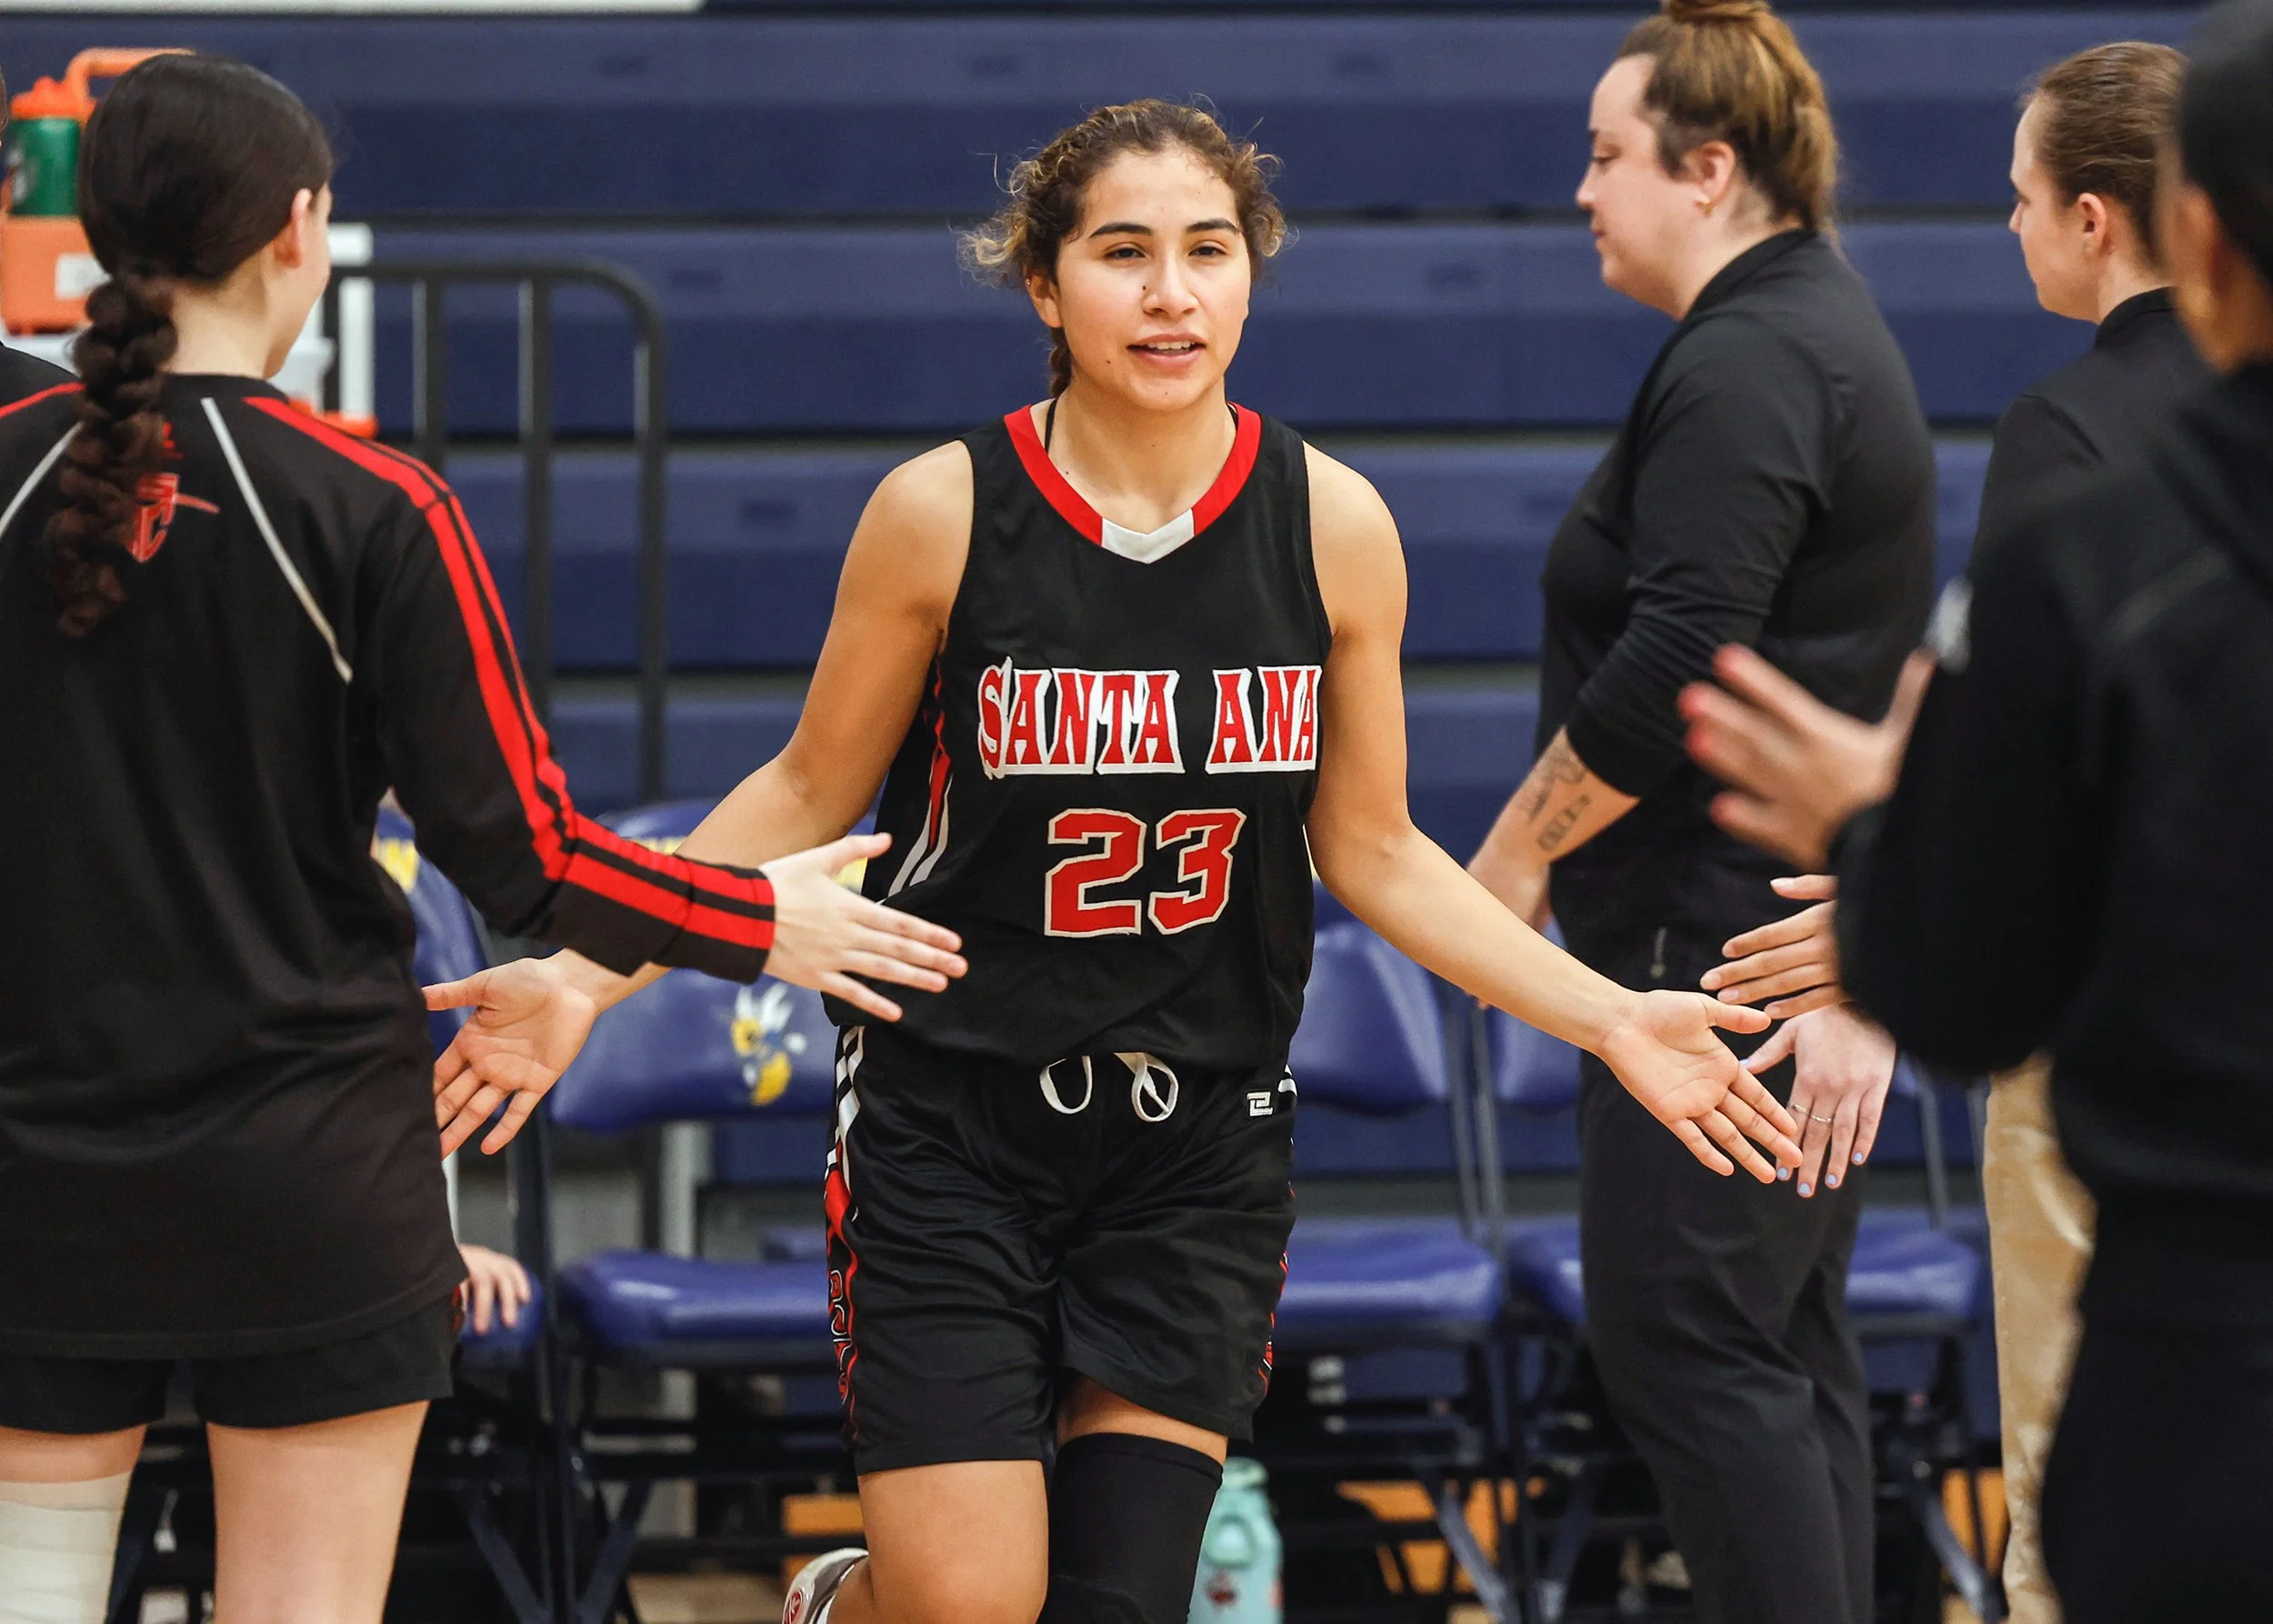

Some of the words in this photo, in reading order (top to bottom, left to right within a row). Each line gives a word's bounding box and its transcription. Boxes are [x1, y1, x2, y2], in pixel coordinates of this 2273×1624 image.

[978, 657, 1185, 779] SANTA
[1206, 666, 1322, 774] ANA
[1045, 808, 1247, 936] 23
